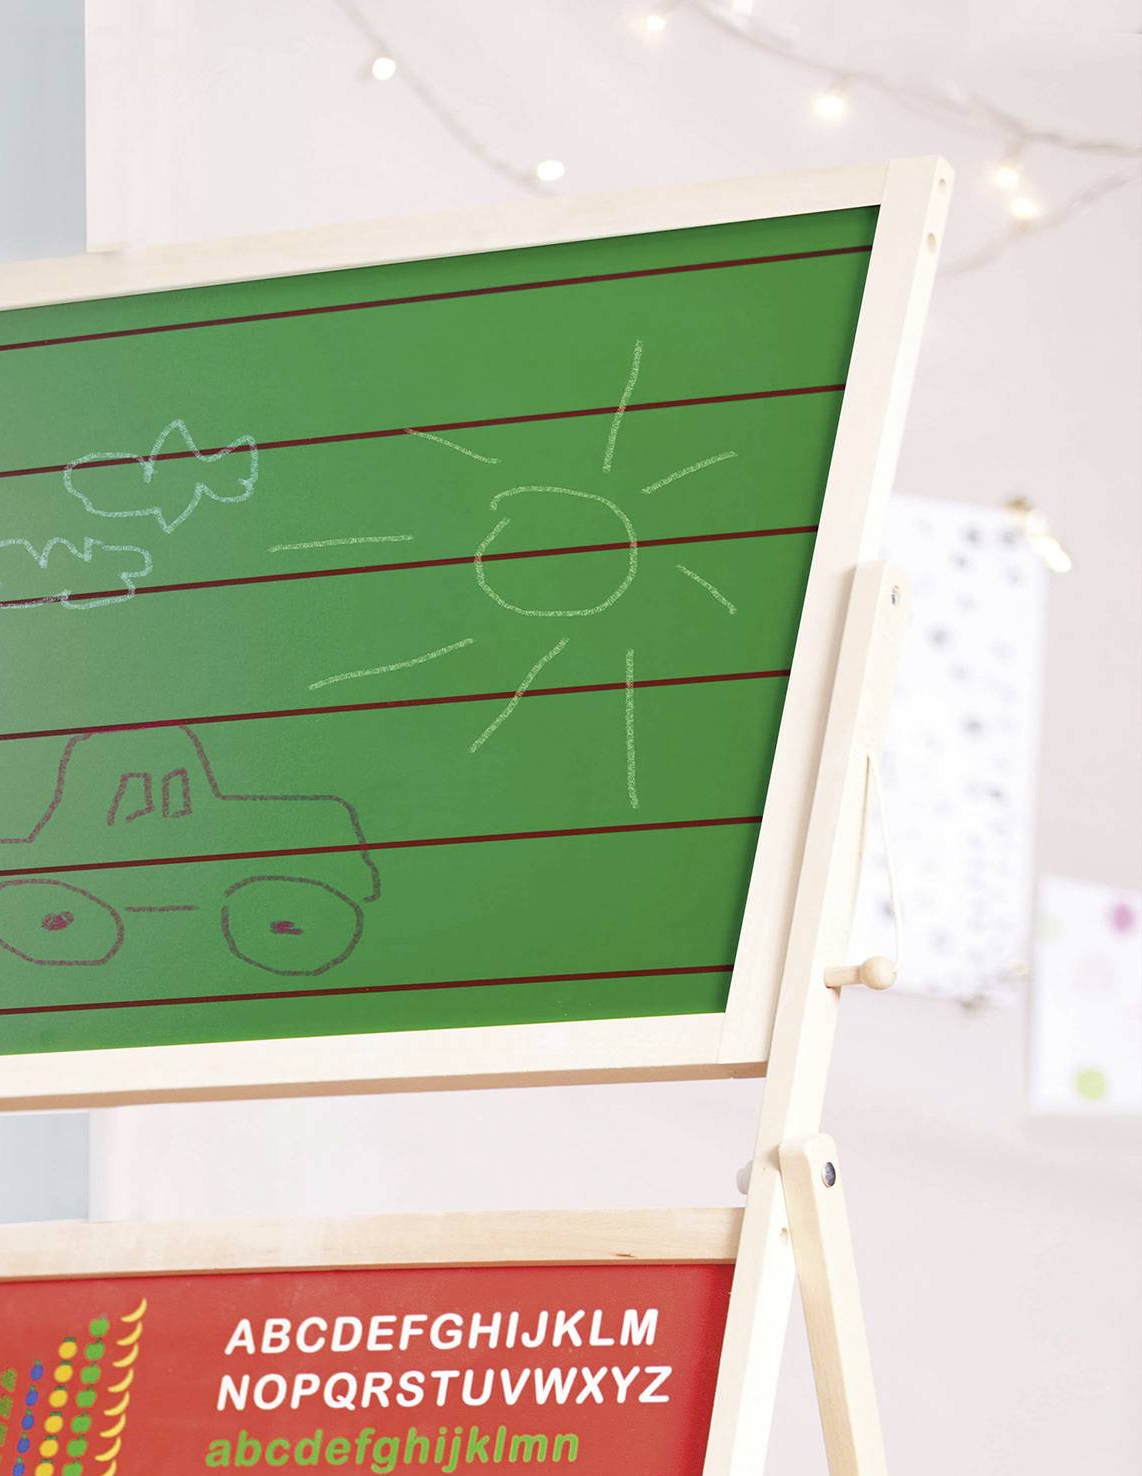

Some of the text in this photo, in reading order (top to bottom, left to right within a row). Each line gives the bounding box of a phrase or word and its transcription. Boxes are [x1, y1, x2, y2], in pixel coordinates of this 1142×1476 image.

[224, 1308, 660, 1357] ABCDEFGHIJKLM
[215, 1365, 674, 1412] NOPQRSTUVWXYZ
[204, 1426, 580, 1474] abcdefghijklmn
